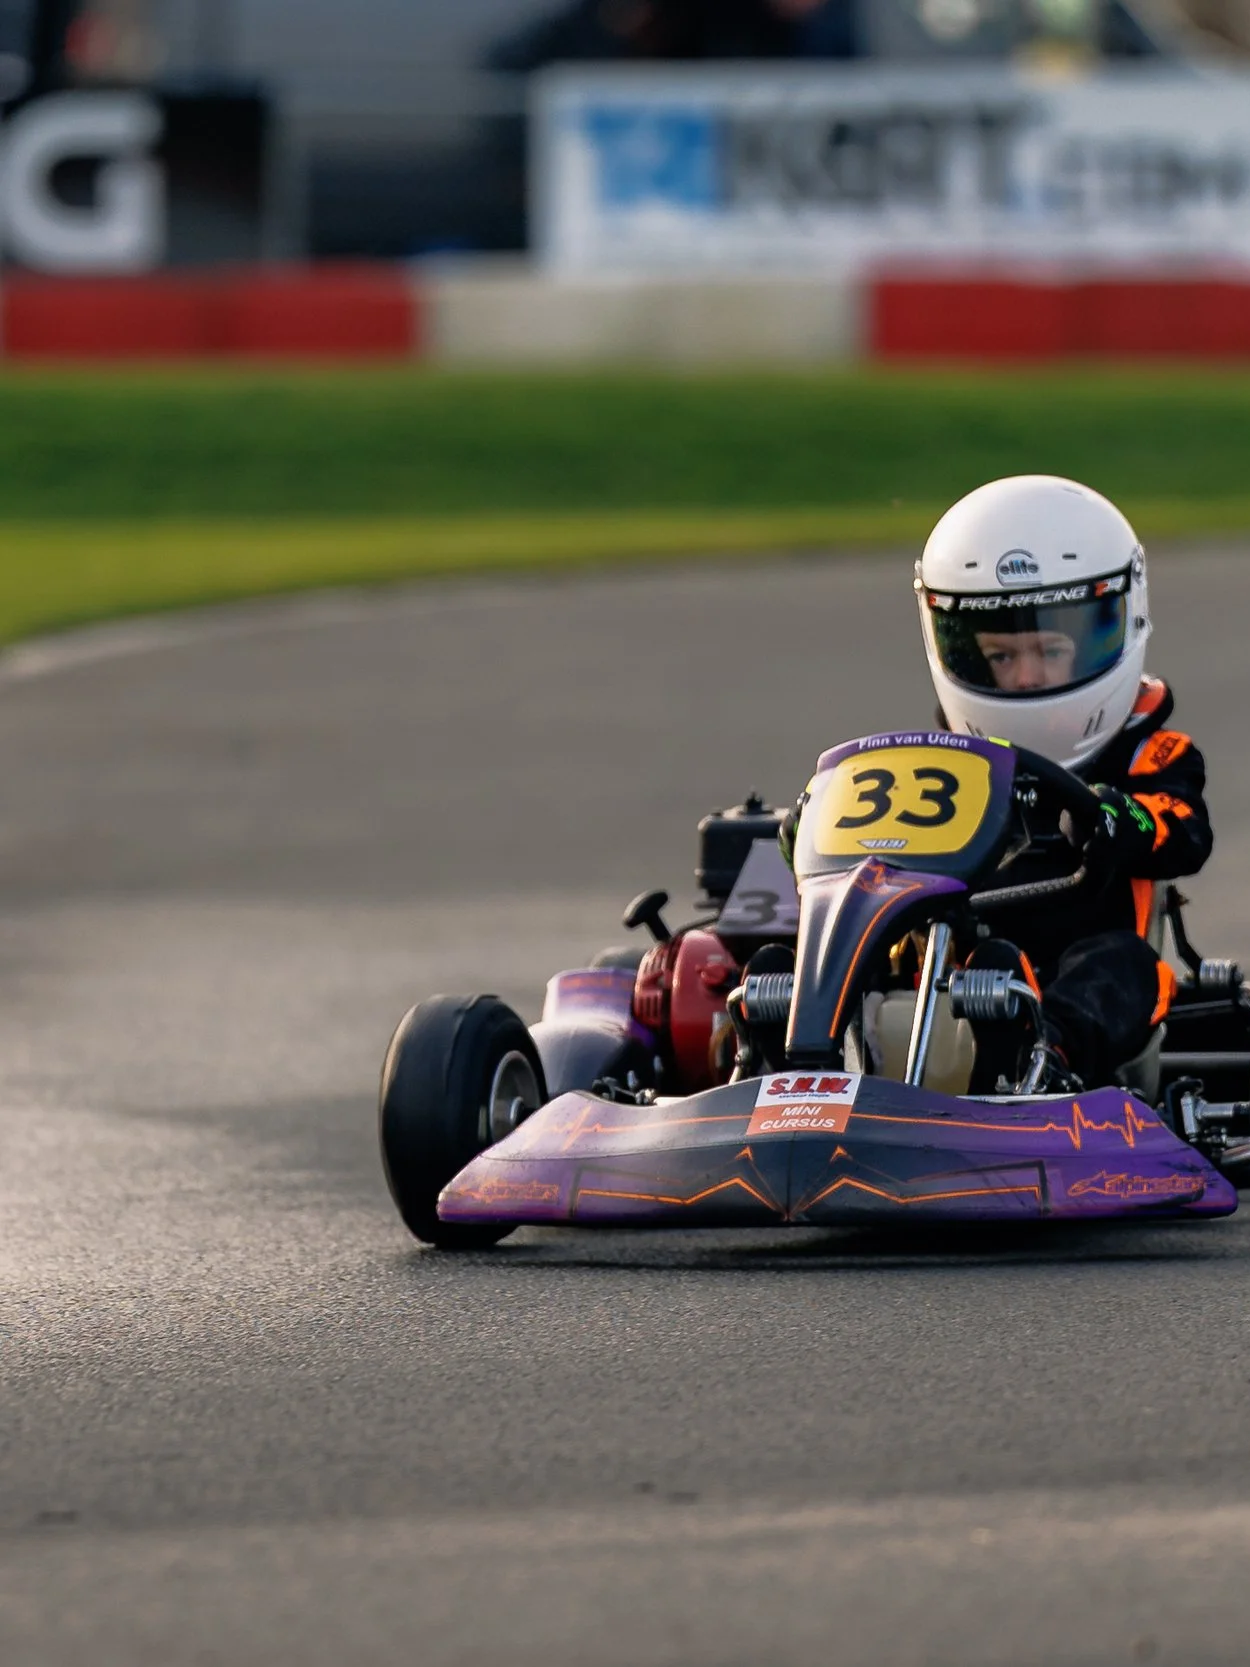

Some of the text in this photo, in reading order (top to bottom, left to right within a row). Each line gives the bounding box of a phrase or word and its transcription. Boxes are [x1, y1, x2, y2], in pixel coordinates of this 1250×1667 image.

[958, 584, 1088, 610] PRO-RACING
[859, 733, 970, 750] Finn van Uden
[835, 767, 959, 828] 33
[781, 1105, 822, 1117] MINI
[760, 1118, 836, 1130] CURSUS
